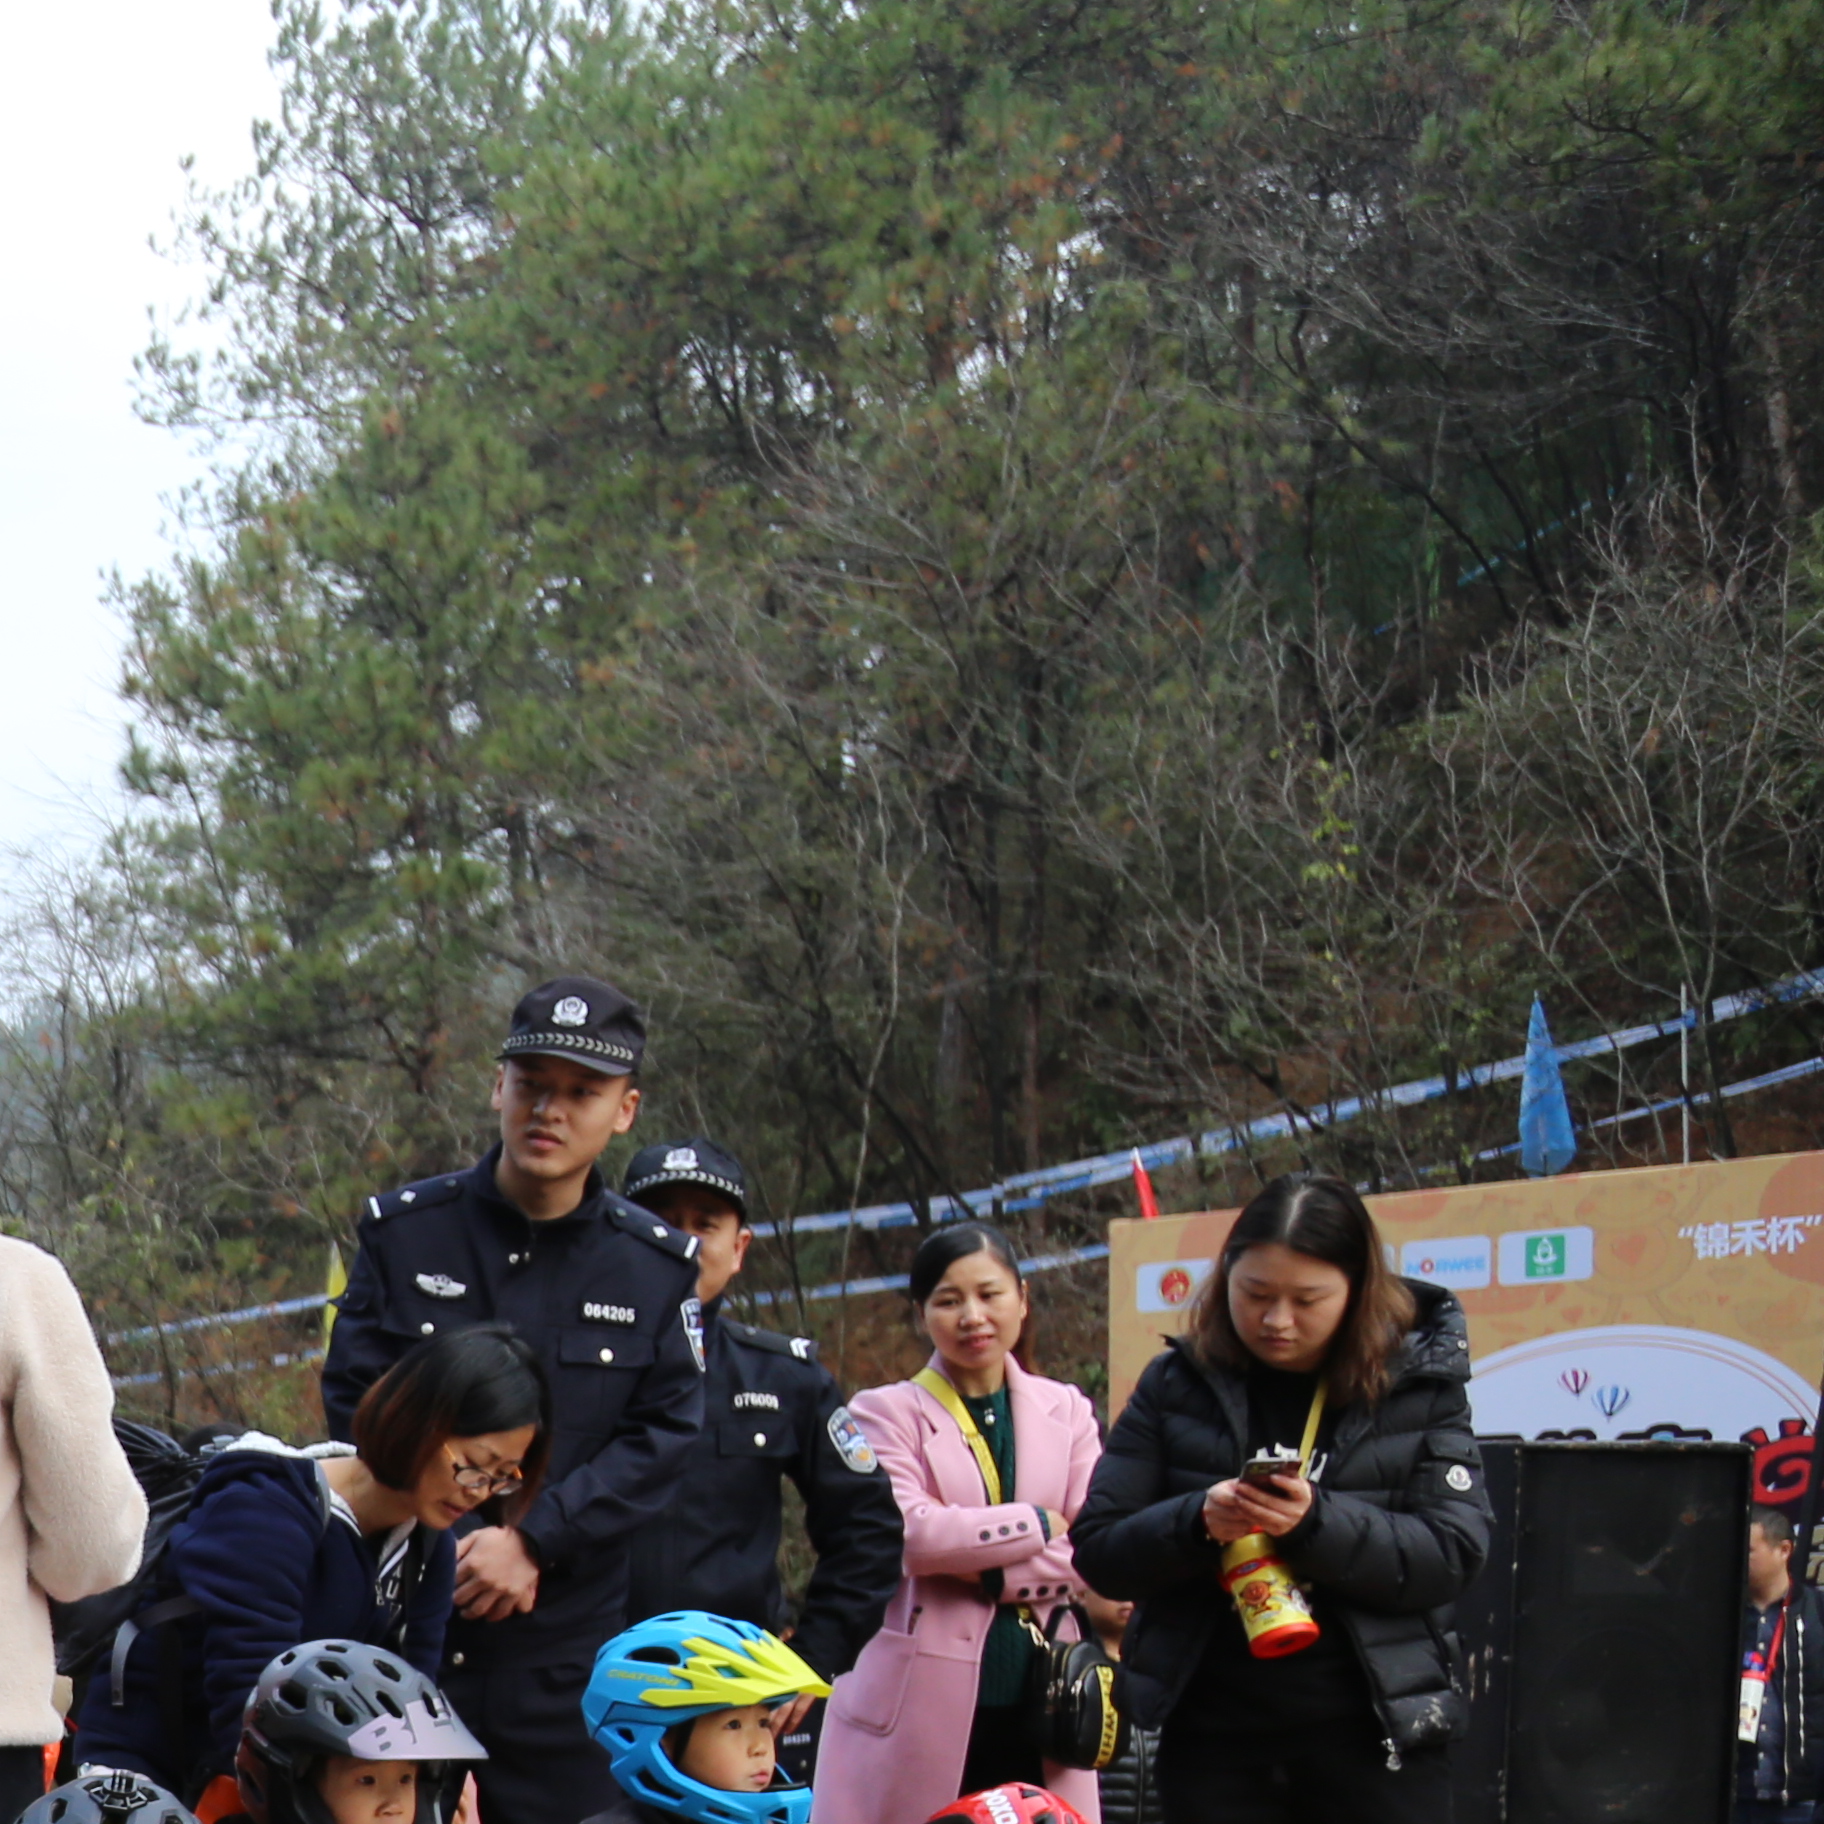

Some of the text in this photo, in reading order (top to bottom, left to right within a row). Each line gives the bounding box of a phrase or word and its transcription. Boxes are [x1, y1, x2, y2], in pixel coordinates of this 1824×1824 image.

[1678, 1214, 1824, 1260] “锦禾杯”
[1403, 1255, 1486, 1276] NORWEE
